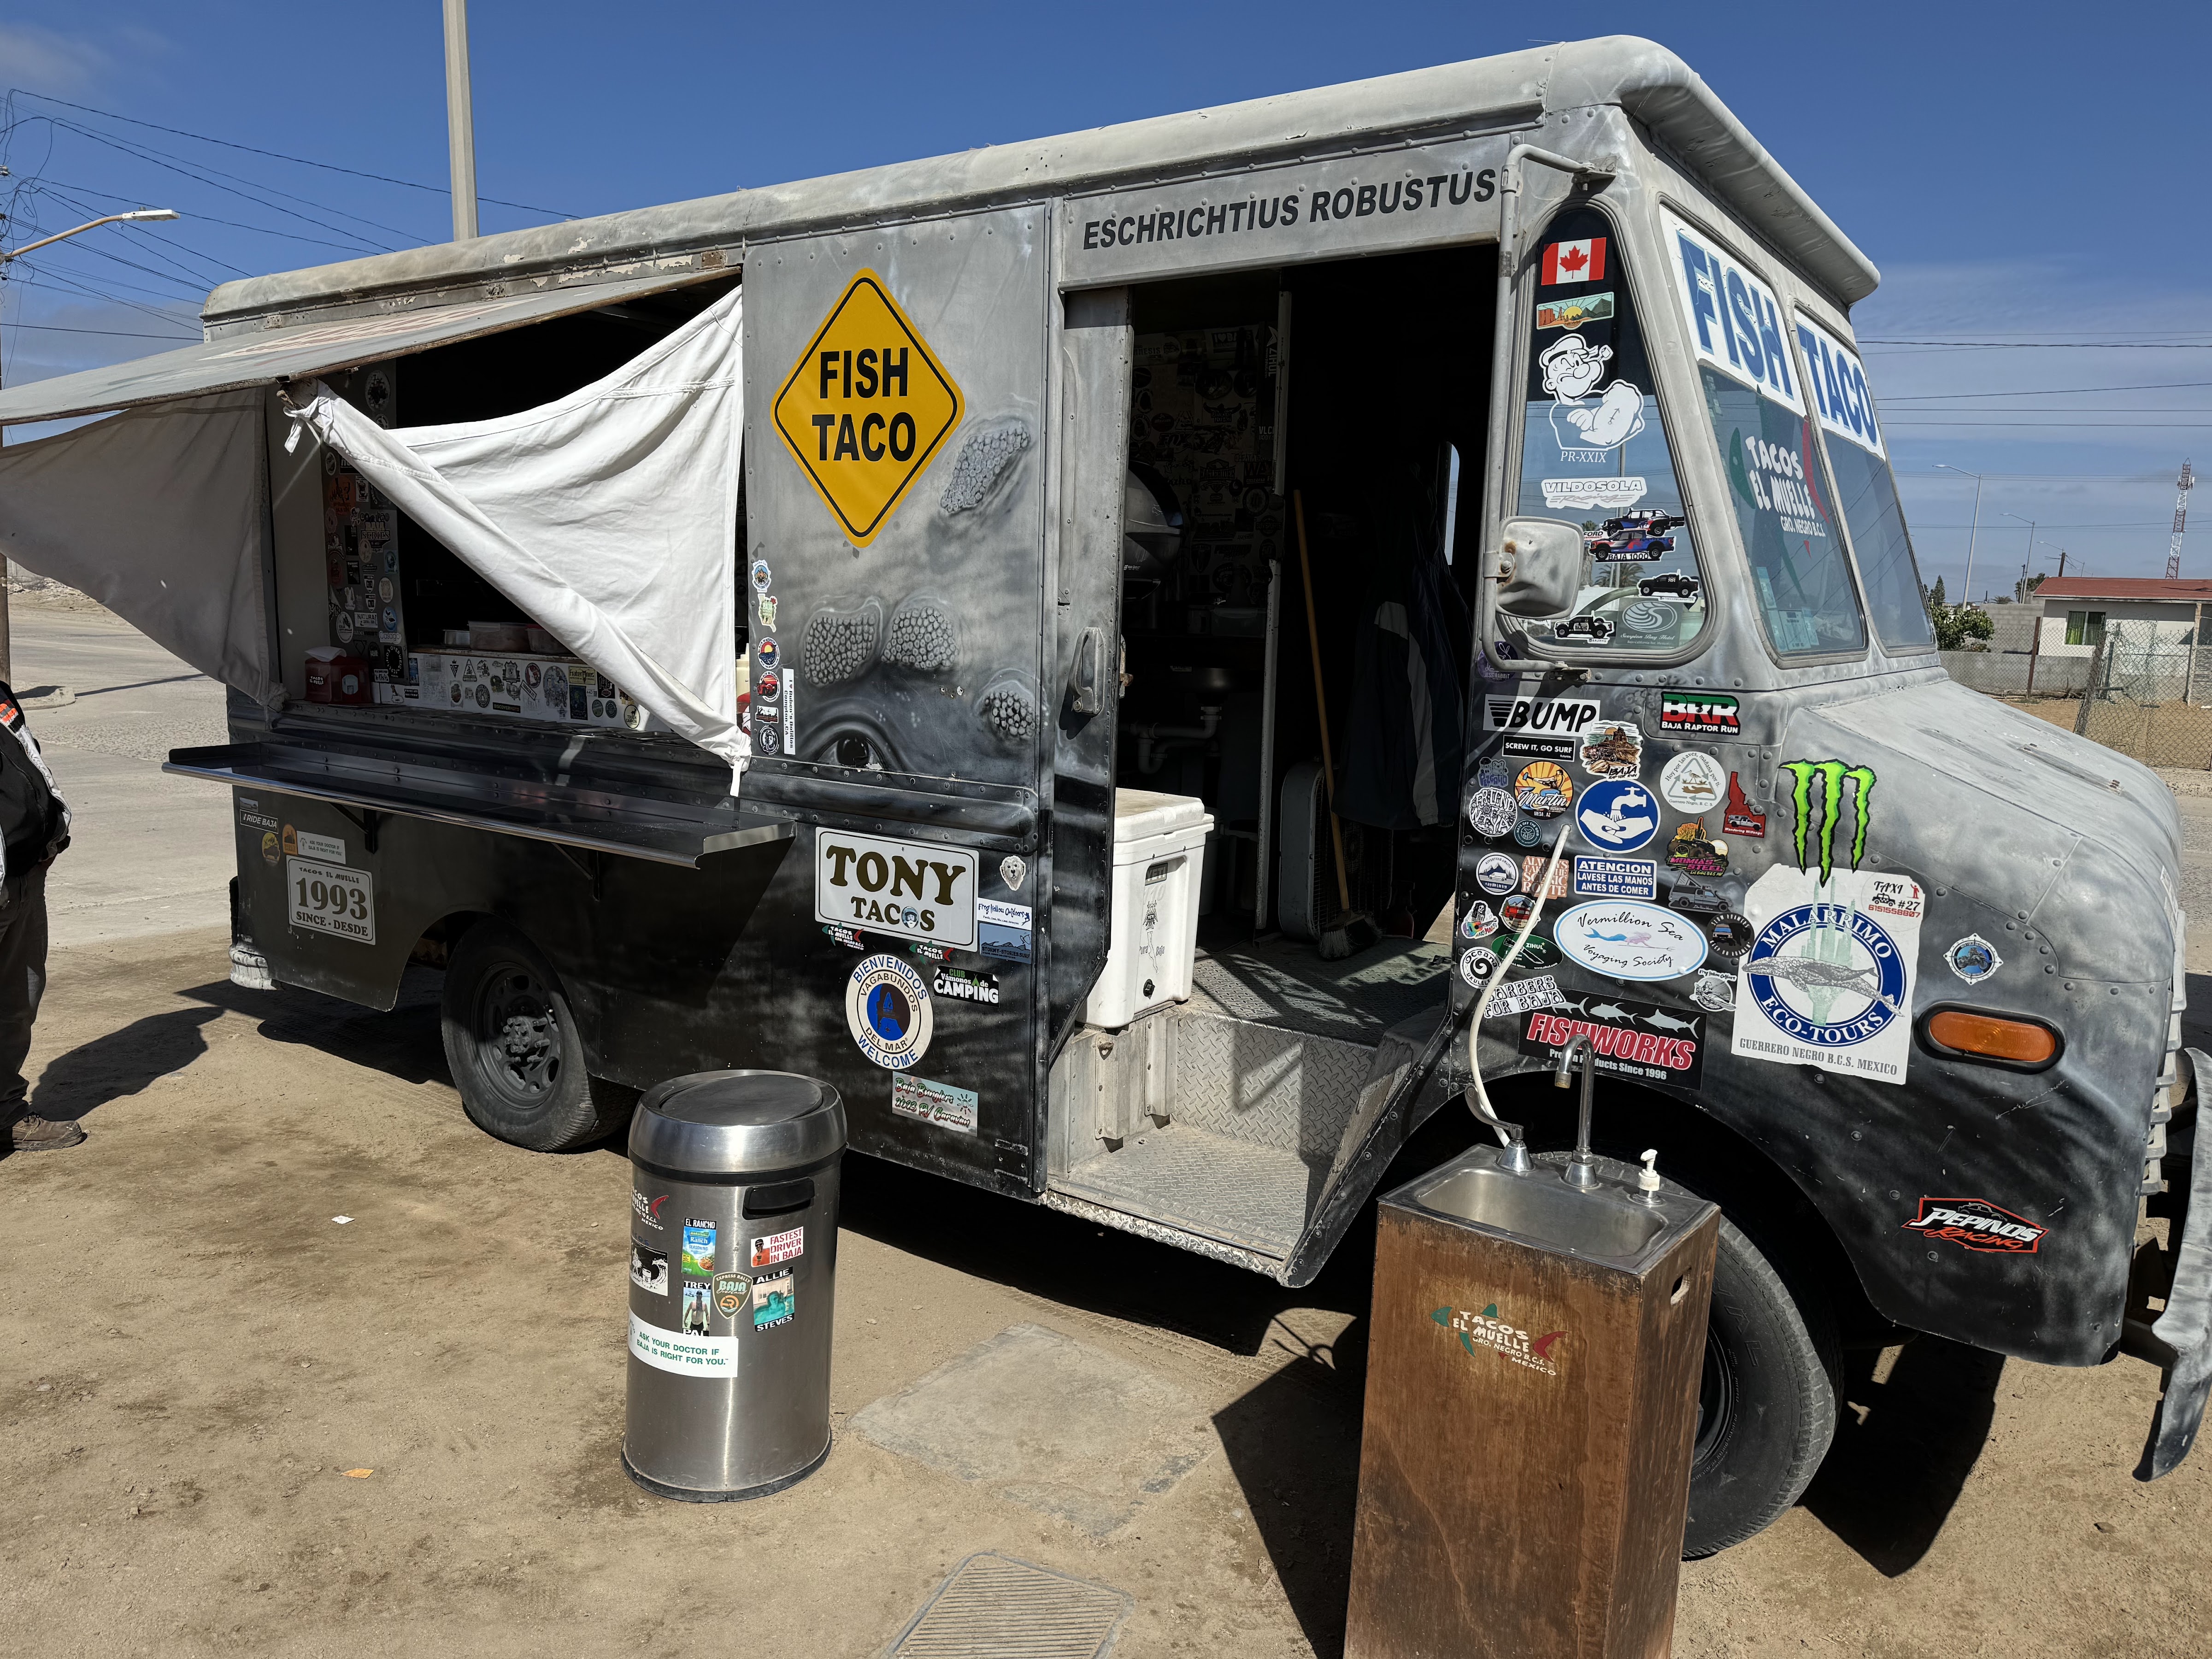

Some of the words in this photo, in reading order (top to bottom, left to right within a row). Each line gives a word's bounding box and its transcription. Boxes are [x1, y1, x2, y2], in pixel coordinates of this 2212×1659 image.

[1083, 195, 1299, 250] ESCHRICHTIUS
[1309, 168, 1497, 223] ROBUSTUS
[1676, 229, 1794, 401] FISH
[820, 347, 908, 399] FISH
[1796, 321, 1877, 447] TACO
[812, 412, 916, 462] TACO
[1560, 451, 1607, 463] PR-XXIX
[1745, 436, 1803, 480] TACOS
[1545, 479, 1643, 493] VILDOSOLA
[1749, 469, 1771, 511] EL
[1770, 475, 1816, 520] MUELLE
[1795, 518, 1813, 536] NEGRO
[1509, 700, 1597, 732] BUMP
[1662, 694, 1739, 725] BRR
[1684, 723, 1718, 732] RAPTOR
[1720, 725, 1739, 734] RUN
[1506, 742, 1530, 750] SCREW
[1609, 765, 1637, 776] BAJA
[1665, 771, 1676, 781] Hoy
[1699, 755, 1712, 772] mañana
[1710, 773, 1718, 784] por
[1518, 791, 1568, 808] Martin
[247, 814, 262, 824] RIDE
[262, 818, 277, 829] BAJA
[299, 867, 323, 875] TACOS
[335, 873, 359, 884] MUELLE
[826, 845, 966, 906] TONY
[1147, 867, 1166, 882] YETI
[1579, 861, 1651, 874] ATENCION
[1577, 872, 1606, 882] LAVESE
[1608, 875, 1623, 883] LAS
[1624, 876, 1653, 886] MANOS
[1874, 881, 1904, 894] TAXI
[1581, 882, 1607, 892] ANTES
[1608, 884, 1619, 893] DE
[1621, 886, 1649, 895] COMER
[296, 877, 367, 920] 1993
[1898, 900, 1921, 911] #27
[978, 903, 990, 915] Frog
[1868, 904, 1921, 918] 6151558807
[296, 911, 326, 927] SINCE
[333, 919, 368, 937] DESDE
[1577, 912, 1652, 928] Vermillion
[1658, 922, 1684, 941] Sea
[1711, 915, 1724, 926] SLOW
[830, 926, 853, 936] TACOS
[835, 931, 853, 941] MUELLE
[1760, 909, 1892, 958] MALARRIMO
[918, 944, 943, 955] TACOS
[924, 951, 944, 960] MUELLE
[1156, 945, 1165, 956] Baja
[1584, 944, 1628, 968] Voyaging
[1633, 954, 1674, 968] Society
[1465, 951, 1498, 968] Oceana
[853, 956, 927, 1000] BIENVENIDOS
[941, 972, 971, 985] Vámonos
[949, 968, 965, 978] CLUB
[860, 973, 918, 1012] VAGABUNDOS
[933, 979, 999, 1004] CAMPING
[1484, 1000, 1512, 1018] FOR
[1517, 990, 1565, 1010] BAJA
[1761, 995, 1883, 1043] ECO-TOURS
[865, 1027, 881, 1047] DEL
[1526, 1012, 1696, 1071] FISHWORKS
[859, 1034, 919, 1068] WELCOME
[1739, 1038, 1789, 1056] GUERRERO
[1792, 1047, 1824, 1063] NEGRO
[1827, 1053, 1854, 1068] B.C.S.
[1857, 1059, 1897, 1076] MEXICO
[1618, 1064, 1644, 1076] Since
[1644, 1067, 1667, 1080] 1996
[895, 1077, 916, 1094] Baja
[917, 1082, 954, 1104] Bunglers
[918, 1103, 935, 1118] RV
[933, 1106, 971, 1128] Caravan
[641, 1217, 664, 1231] MEXICO
[685, 1218, 692, 1227] EL
[693, 1219, 716, 1230] RANCHO
[1908, 1207, 2043, 1242] PEPINOS
[690, 1236, 708, 1245] Ranch
[770, 1228, 802, 1245] FASTEST
[771, 1238, 801, 1253] DRIVER
[771, 1254, 780, 1263] IN
[782, 1247, 802, 1259] BAJA
[737, 1275, 751, 1283] RALLY
[756, 1268, 790, 1284] ALLIE
[683, 1281, 711, 1290] TREY
[719, 1281, 747, 1292] BAJA
[757, 1314, 793, 1332] STEVES
[1459, 1310, 1529, 1341] TACOS
[639, 1331, 650, 1342] ASK
[652, 1337, 670, 1349] YOUR
[673, 1344, 707, 1355] DOCTOR
[1453, 1318, 1468, 1332] EL
[1472, 1325, 1530, 1353] MUELLE
[636, 1339, 649, 1352] BAJA
[660, 1350, 683, 1362] RIGHT
[1493, 1343, 1522, 1358] NEGRO
[1524, 1353, 1545, 1366] B.C.S.
[1511, 1357, 1557, 1376] MEXICO
